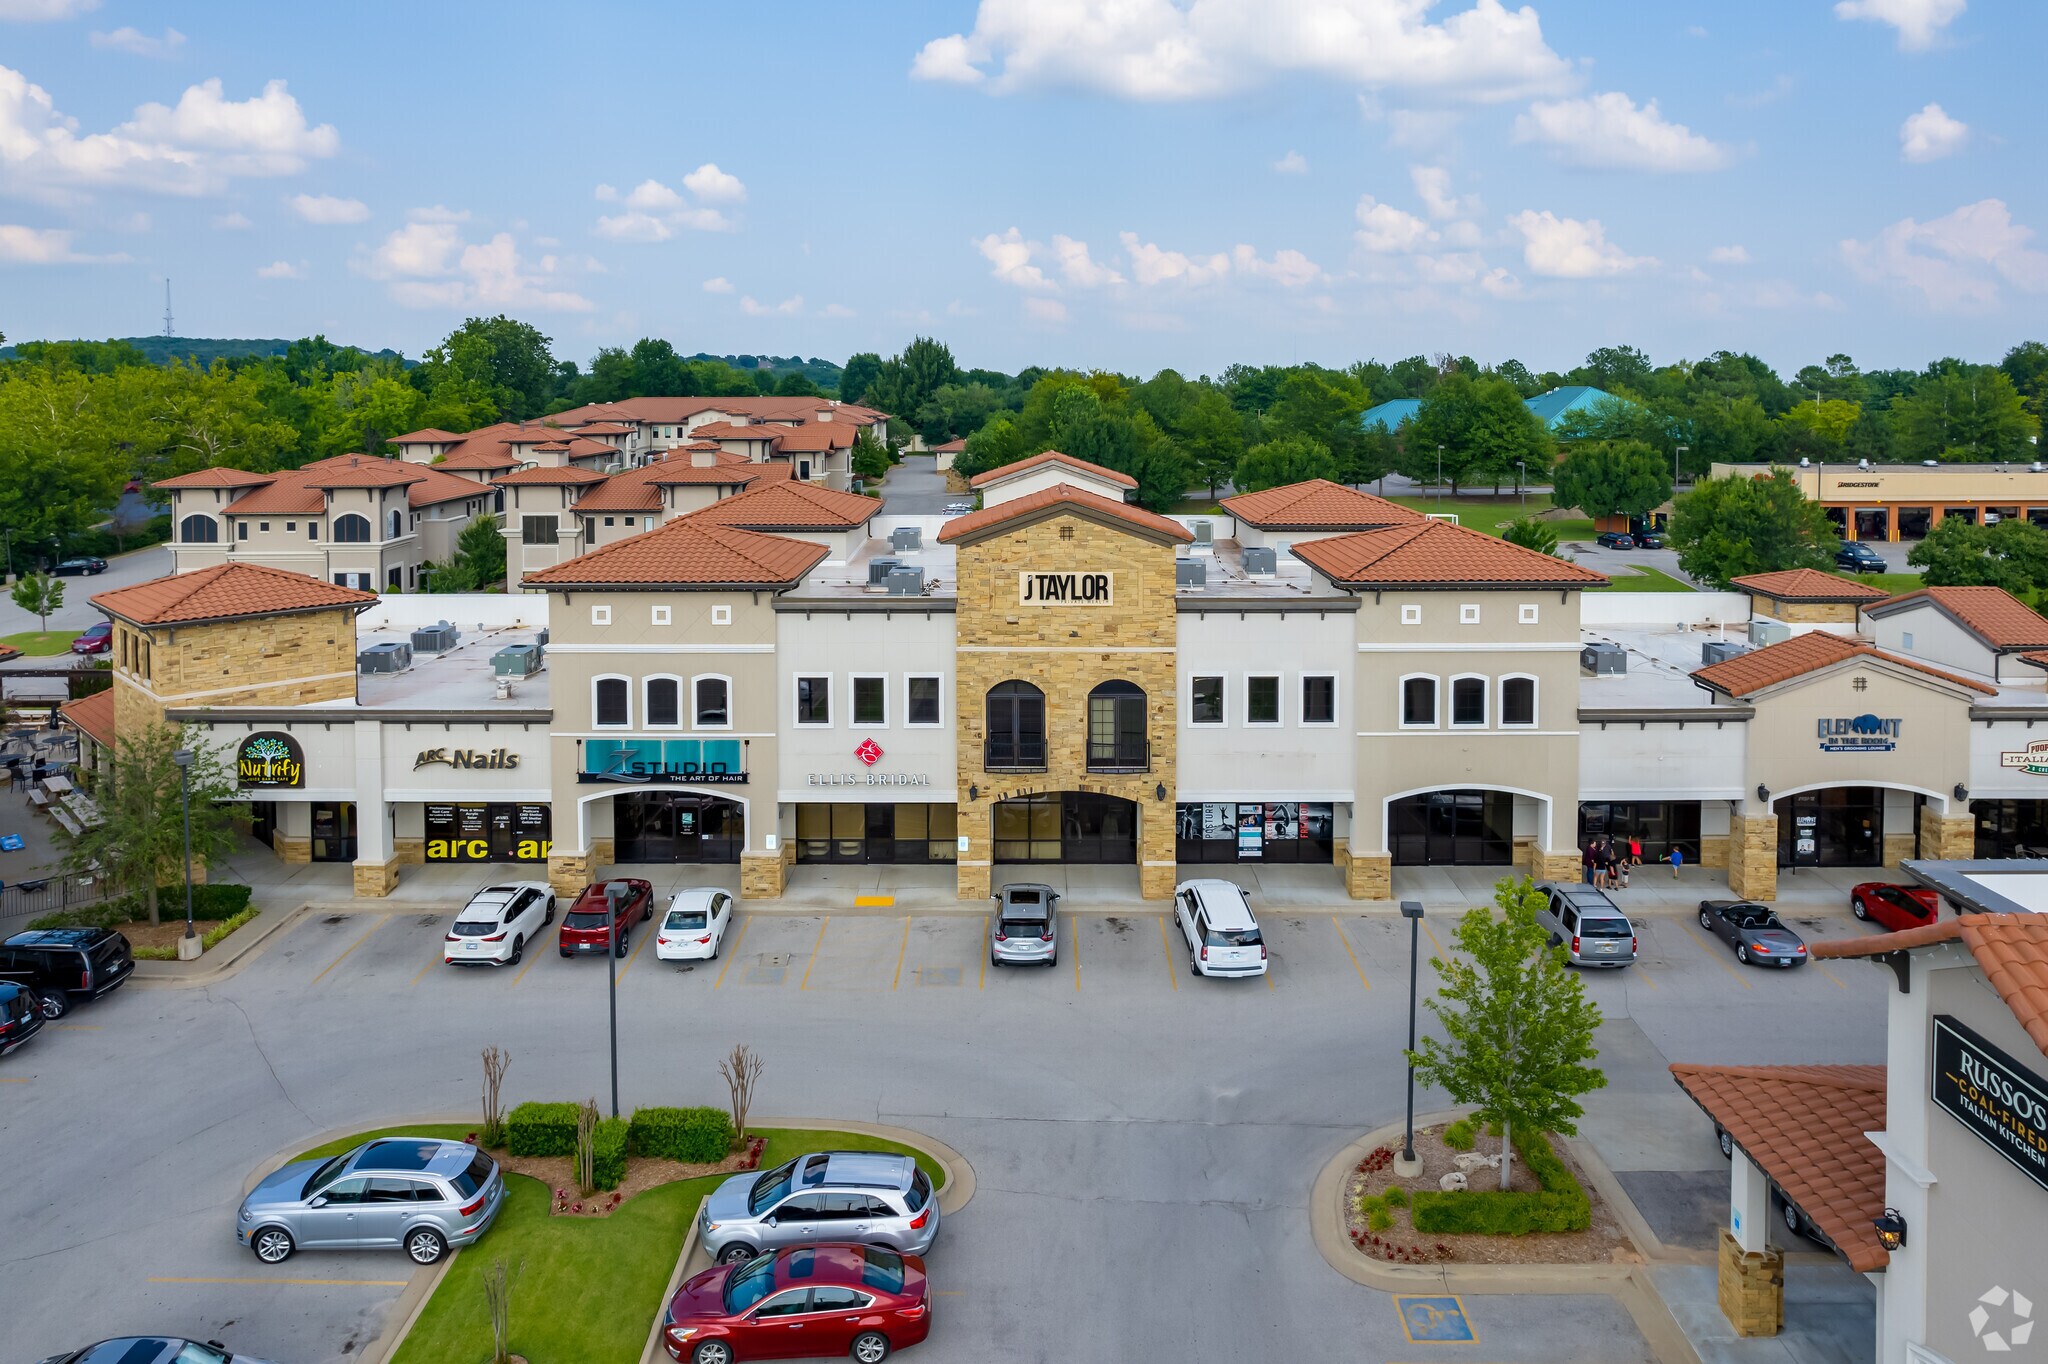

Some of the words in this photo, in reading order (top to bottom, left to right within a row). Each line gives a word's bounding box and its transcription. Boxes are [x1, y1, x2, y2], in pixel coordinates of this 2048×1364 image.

[1035, 575, 1109, 600] TAYLOR
[1818, 718, 1903, 738] ELEPNT
[240, 759, 301, 785] Nutrify
[415, 748, 445, 766] ARC
[452, 748, 518, 770] Nails
[596, 749, 651, 783] Z
[631, 762, 727, 775] STUDIO
[808, 774, 856, 786] ELLIS
[866, 774, 930, 786] BRIDAL
[1205, 804, 1213, 839] POSTURE
[1300, 804, 1308, 839] FRDOM
[427, 839, 489, 859] arc
[1959, 1049, 2048, 1132] RUSSO'S
[1959, 1093, 1998, 1131] ITALIAN
[1998, 1123, 2047, 1168] KITCHEN
